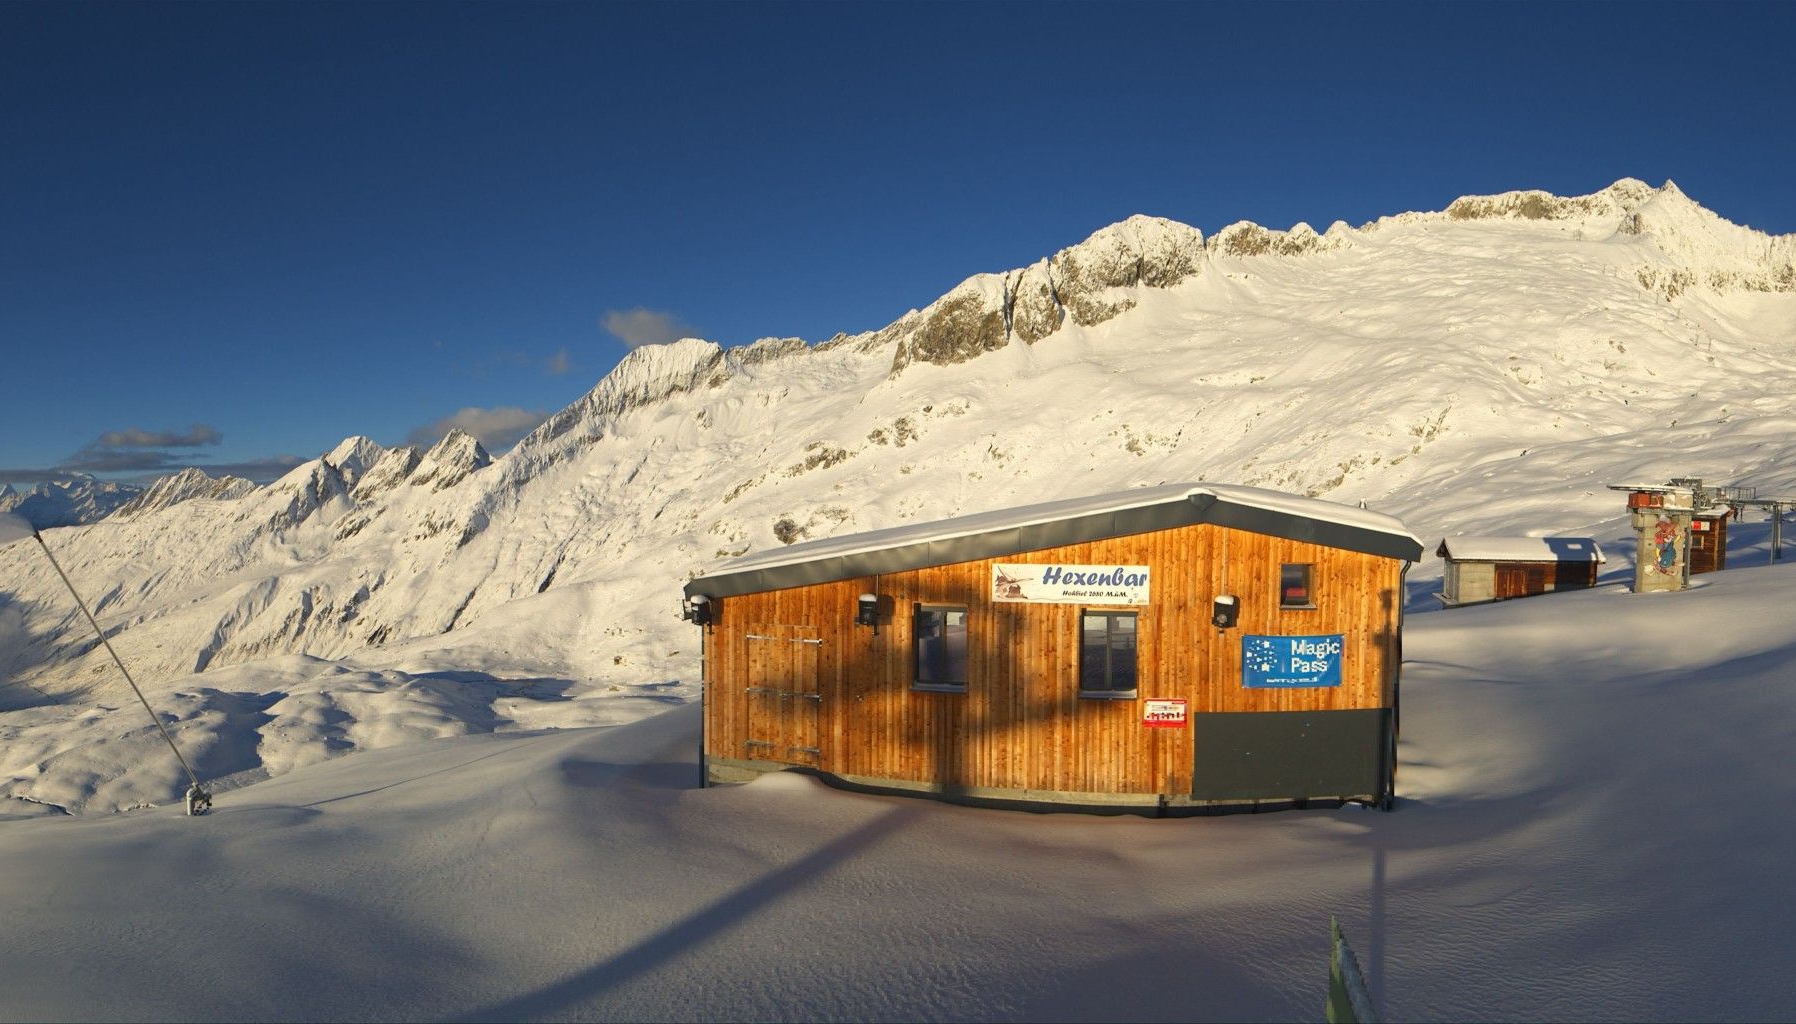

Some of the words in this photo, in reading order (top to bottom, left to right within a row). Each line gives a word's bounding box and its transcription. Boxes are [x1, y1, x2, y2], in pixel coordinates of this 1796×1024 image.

[1043, 566, 1147, 587] Hexenbar
[1291, 638, 1340, 659] Magic
[1291, 657, 1327, 673] Pass
